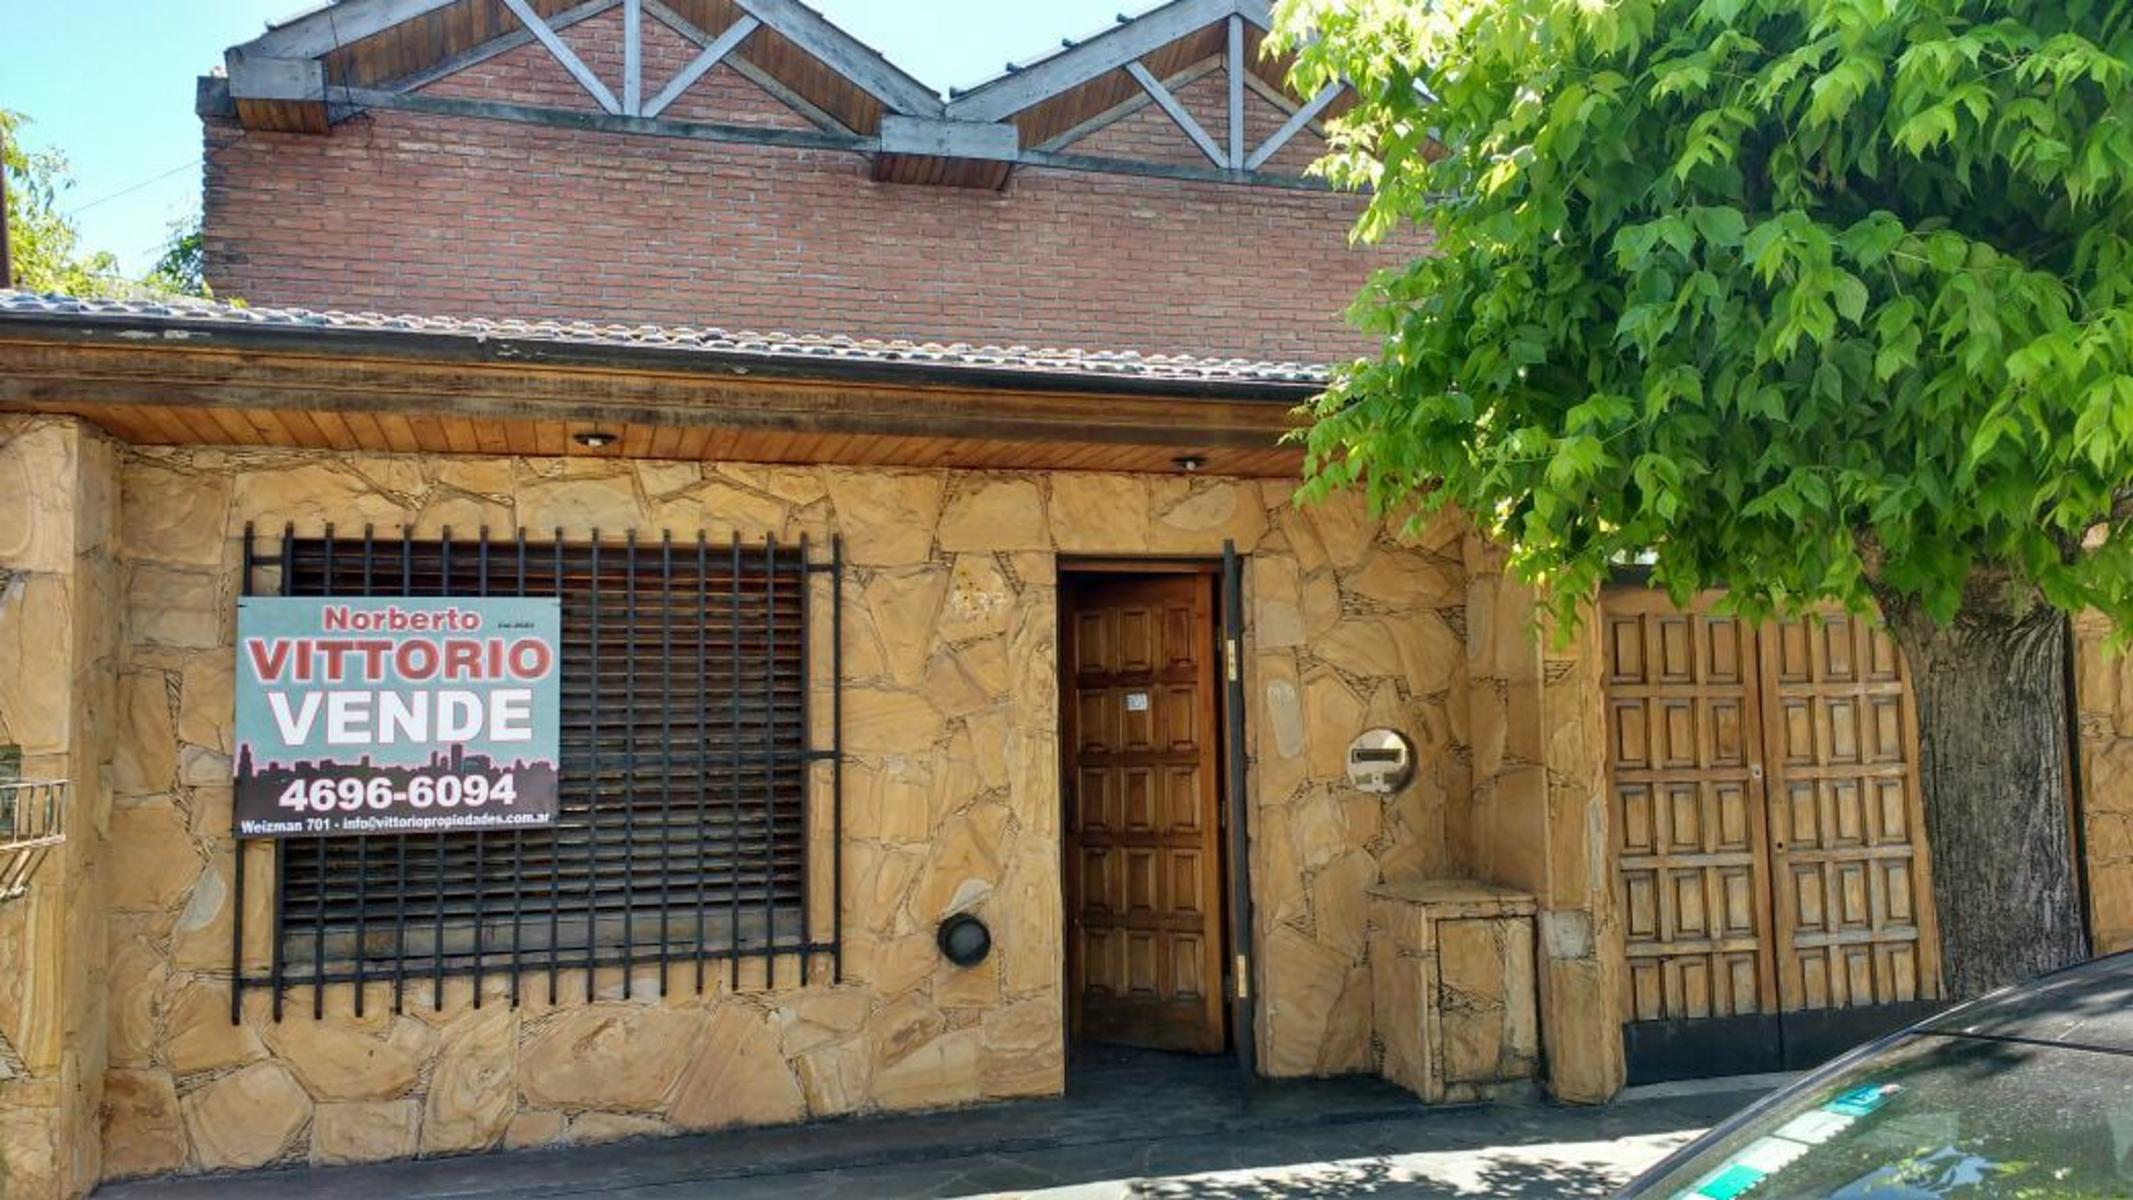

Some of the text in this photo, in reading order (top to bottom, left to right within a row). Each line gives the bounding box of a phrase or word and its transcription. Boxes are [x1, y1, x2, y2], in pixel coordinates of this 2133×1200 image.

[324, 606, 480, 630] Norberto
[249, 638, 551, 681] VITTORIO
[268, 689, 533, 745] VENDE
[278, 773, 517, 811] 4696-6094
[241, 819, 303, 834] Weizman
[306, 817, 330, 832] 701
[342, 812, 550, 831] info@vittoriopropiedades.com.ar
